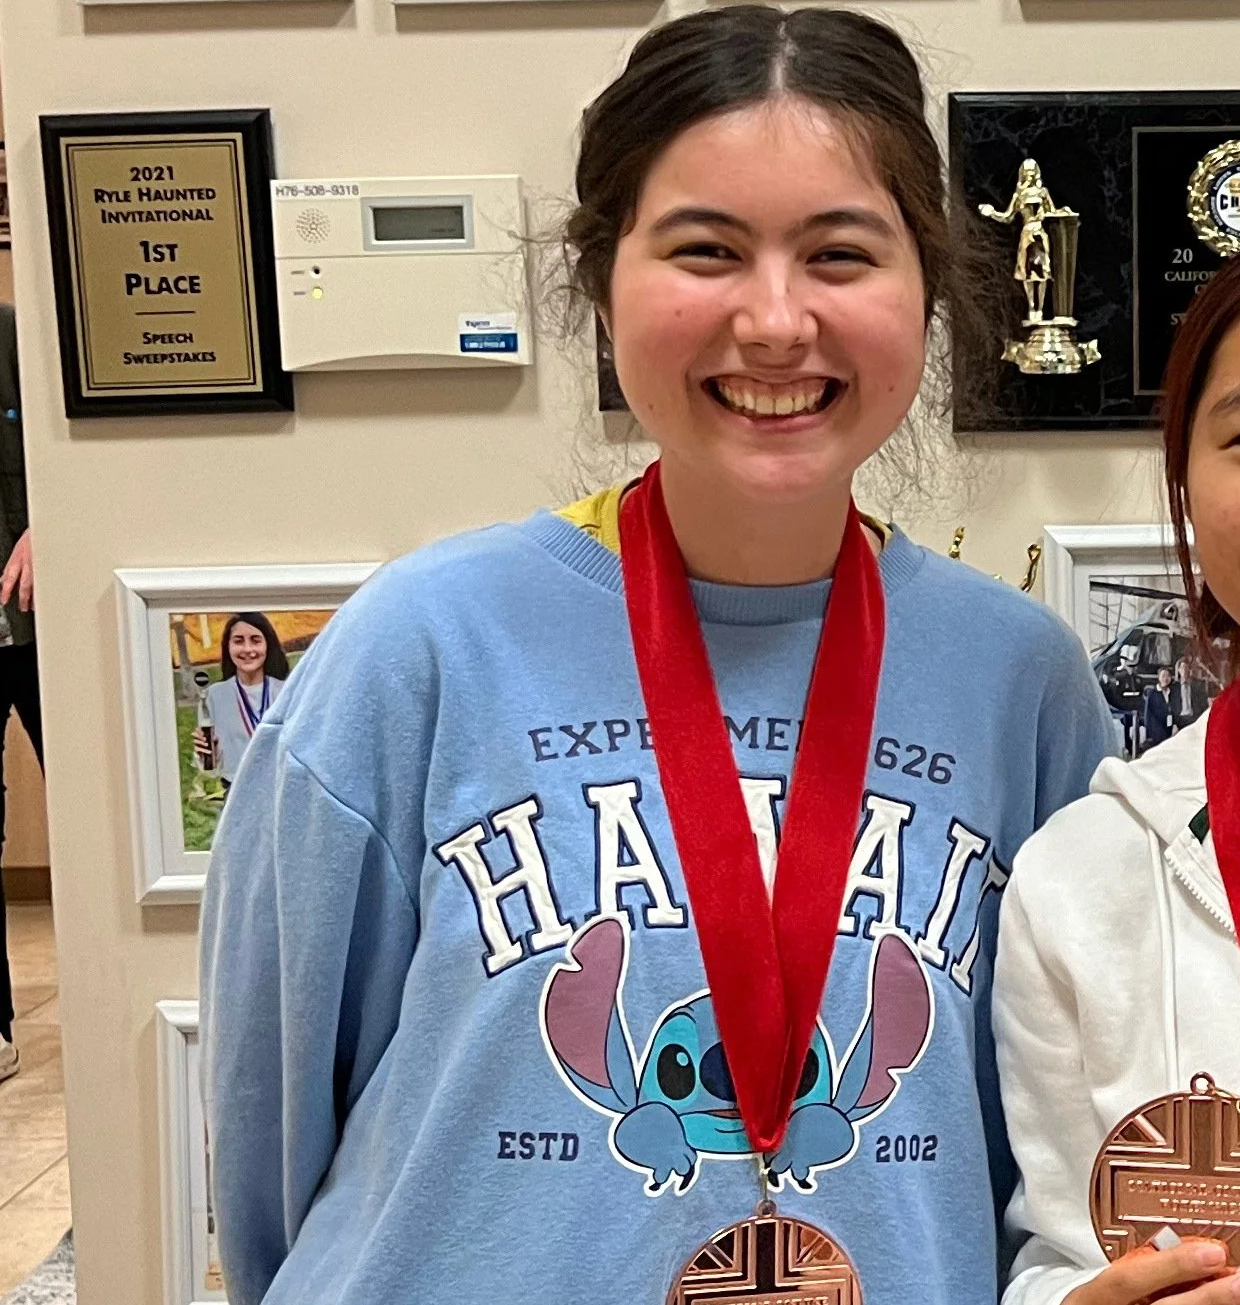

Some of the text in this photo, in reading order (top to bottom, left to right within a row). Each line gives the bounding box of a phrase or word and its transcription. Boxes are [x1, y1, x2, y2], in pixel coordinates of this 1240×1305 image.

[130, 166, 174, 182] 2021
[94, 187, 216, 204] RYLE HAUNTED
[101, 208, 214, 224] INVITATIONAL
[139, 240, 178, 263] 1ST
[124, 273, 202, 296] PLACE
[1164, 271, 1216, 282] CALIFO
[142, 332, 194, 345] SPEECH
[123, 351, 216, 365] SWEEPSTAKES
[527, 715, 957, 786] EXPEME 626
[432, 777, 1010, 996] HAAII
[498, 1132, 580, 1162] ESTD
[875, 1133, 940, 1164] 2002
